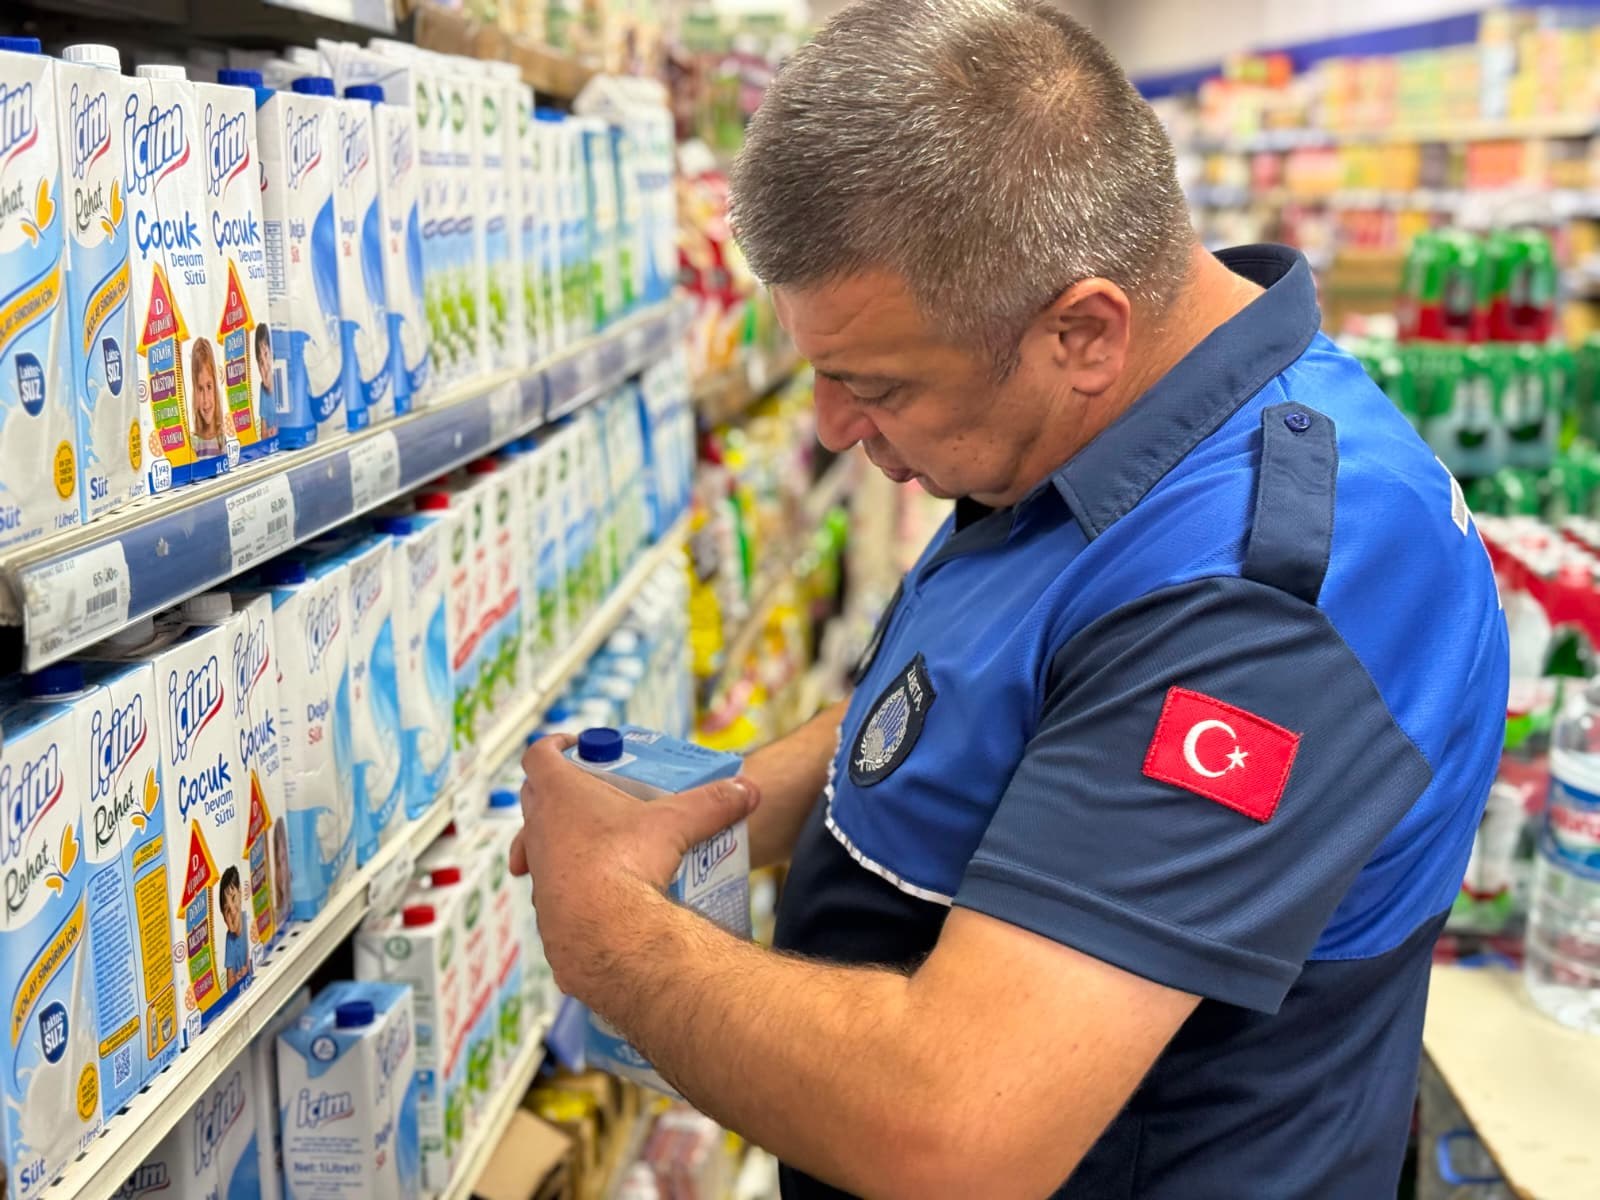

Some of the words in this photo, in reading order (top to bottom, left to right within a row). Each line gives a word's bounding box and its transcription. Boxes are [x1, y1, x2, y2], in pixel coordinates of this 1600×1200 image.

[75, 185, 104, 235] Rahat
[135, 210, 202, 260] Çocuk
[212, 210, 261, 256] Çocuk
[171, 252, 204, 268] Devam
[184, 270, 206, 286] Sütü
[155, 298, 164, 315] D
[90, 476, 108, 500] Süt
[169, 655, 218, 766] İçim
[91, 693, 142, 802] İçim
[240, 709, 276, 773] Çocuk
[179, 753, 232, 823] Çocuk
[204, 790, 233, 817] Devam
[94, 781, 134, 859] Rahat
[215, 805, 235, 828] Sütü
[5, 839, 50, 926] Rahat
[192, 854, 199, 872] D
[44, 1022, 65, 1054] SUZ
[20, 1158, 46, 1193] Süt
